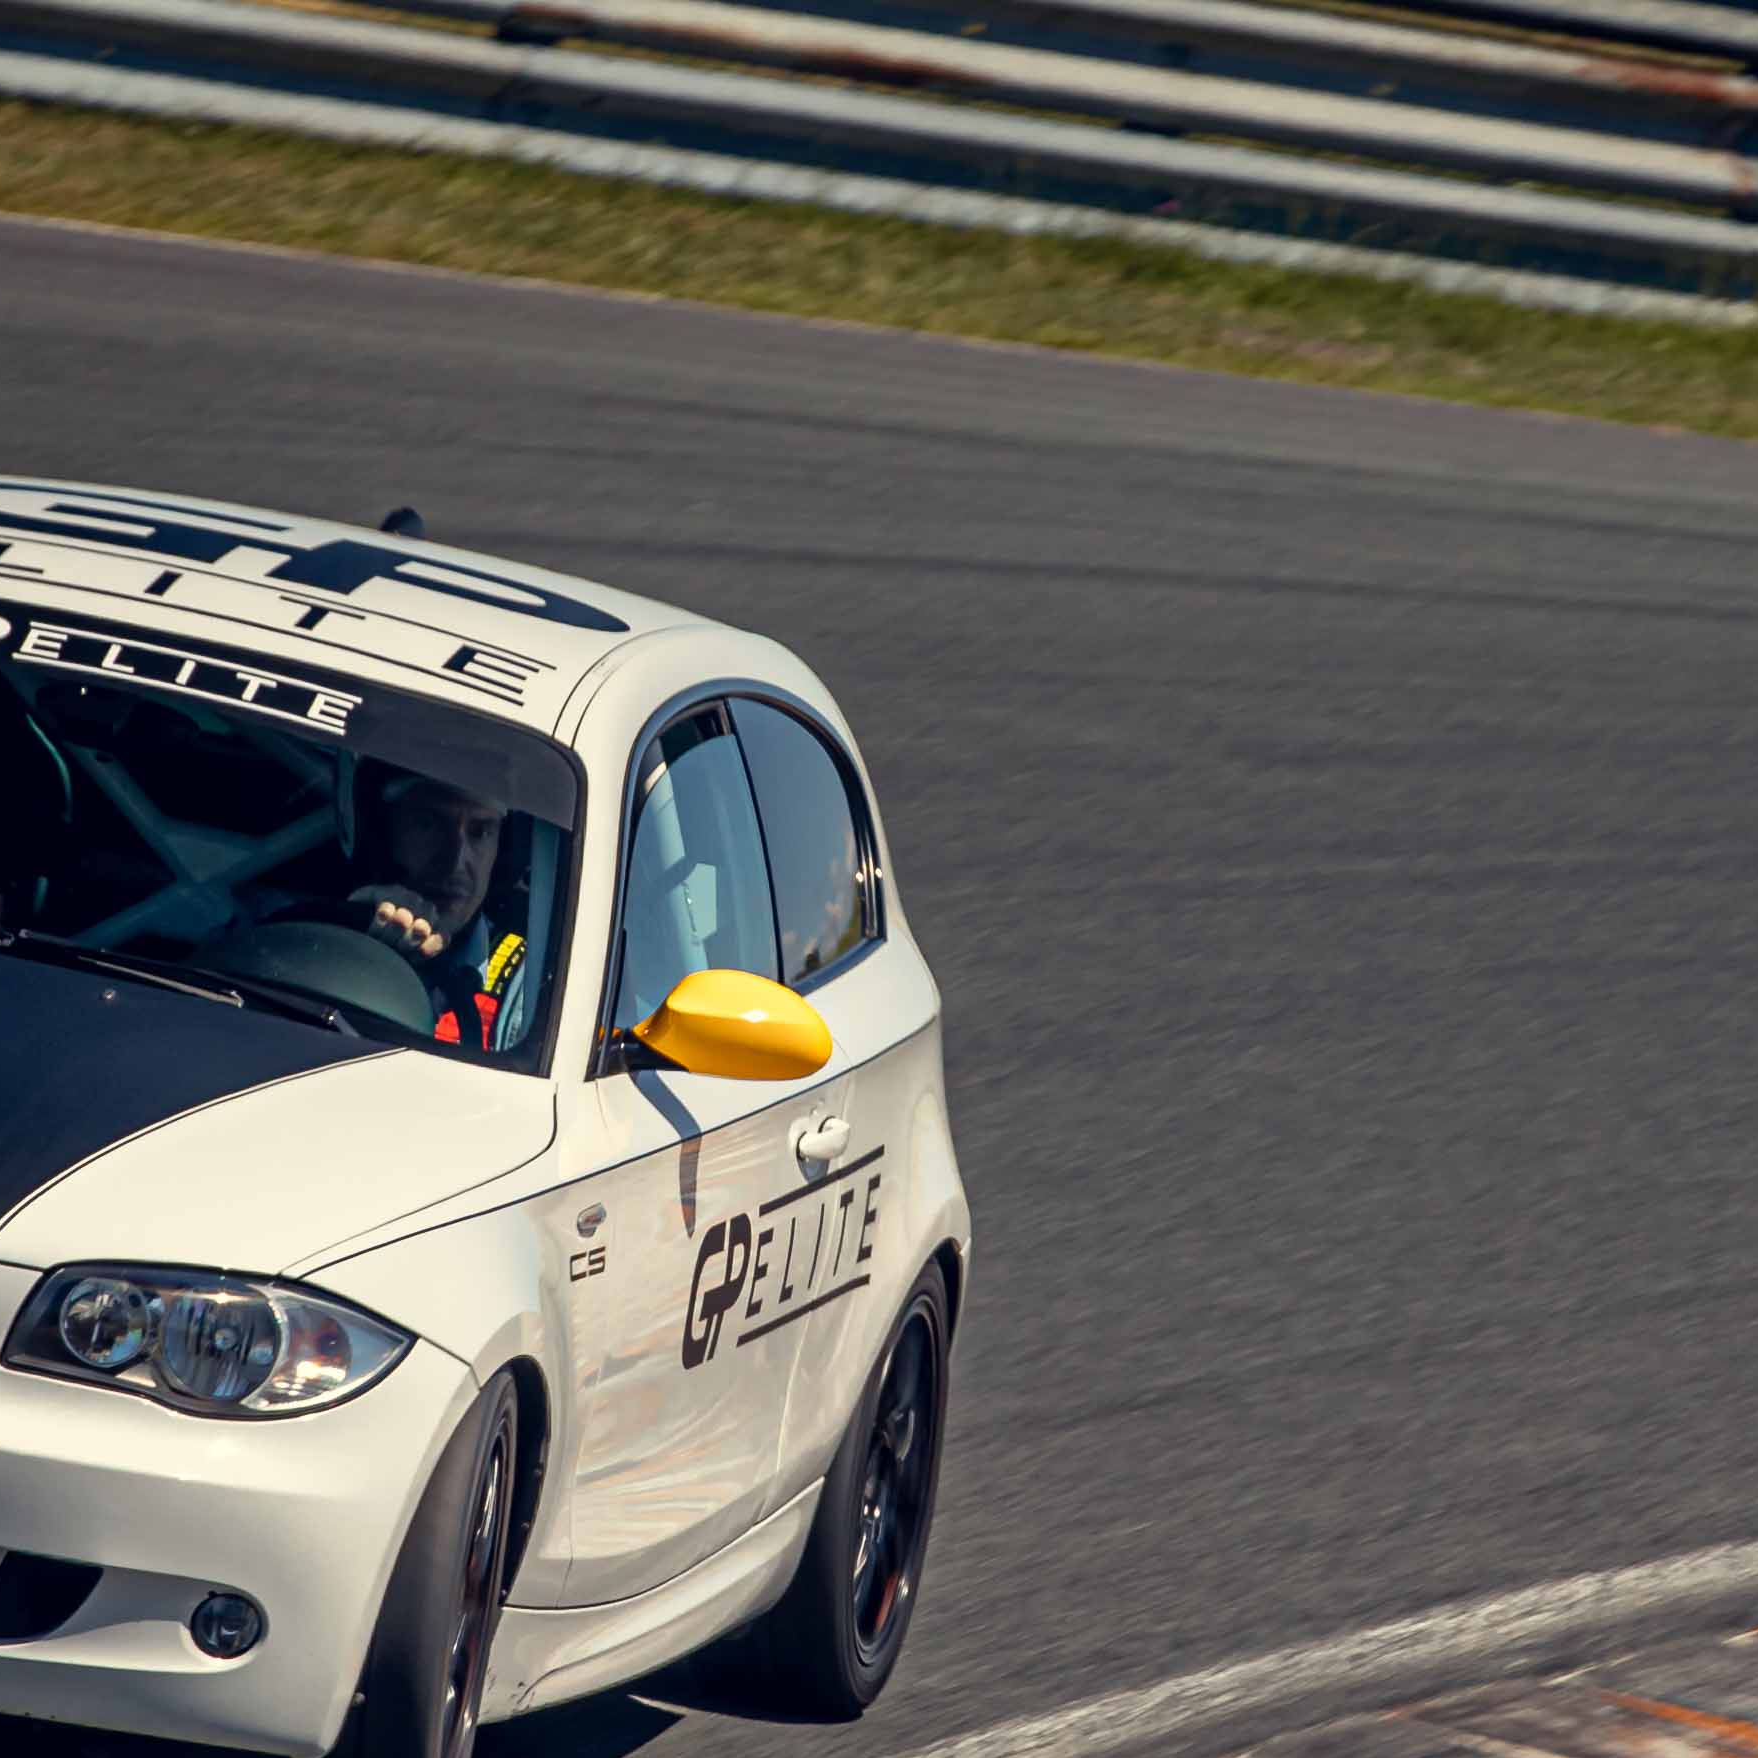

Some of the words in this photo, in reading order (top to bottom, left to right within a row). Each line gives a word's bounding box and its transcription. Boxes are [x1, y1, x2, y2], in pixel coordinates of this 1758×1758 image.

[21, 627, 360, 722] ELITE
[682, 1212, 751, 1370] GP
[745, 1174, 881, 1318] ELITE
